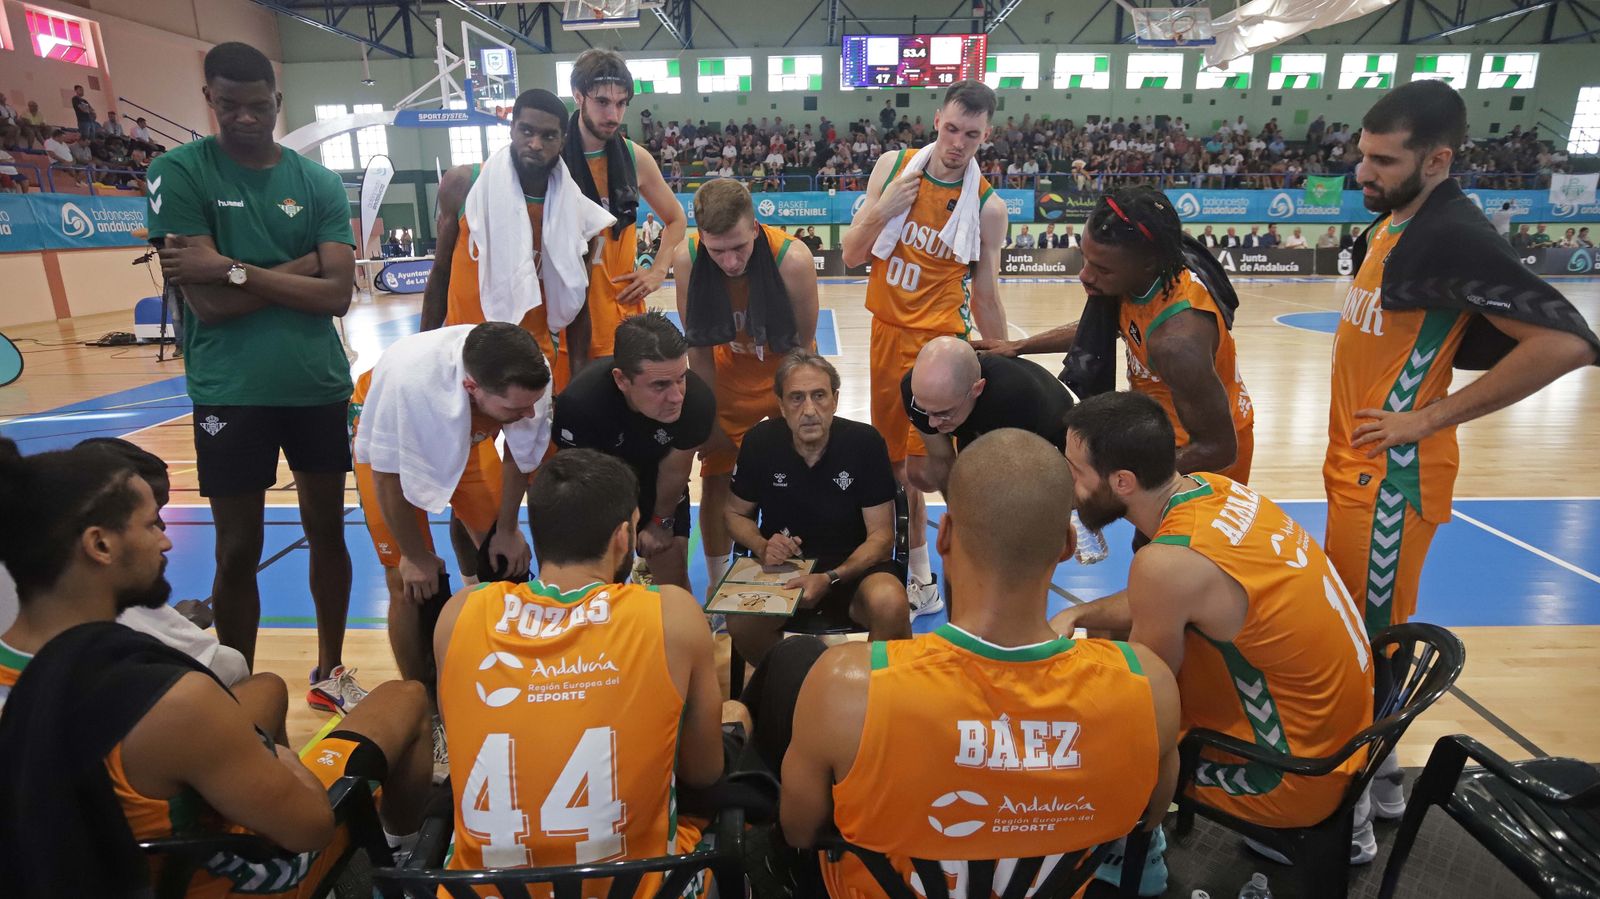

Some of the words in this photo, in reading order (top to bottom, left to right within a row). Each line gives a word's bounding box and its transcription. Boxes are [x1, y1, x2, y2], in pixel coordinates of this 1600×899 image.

[876, 74, 890, 84] 17
[938, 73, 953, 83] 18
[217, 199, 244, 208] hummel
[778, 200, 808, 208] BASKET
[91, 208, 144, 221] baloncesto
[778, 207, 827, 217] SOSTENIBLE
[1006, 254, 1033, 263] Junta
[1240, 254, 1267, 263] Junta
[1006, 263, 1019, 272] de
[1019, 262, 1066, 272] Andalucía
[1240, 263, 1251, 272] de
[1252, 262, 1299, 272] Andalucía
[886, 256, 921, 292] 00
[531, 652, 620, 679] Andalucía
[528, 683, 560, 694] Región
[563, 680, 602, 691] Europea
[605, 677, 620, 686] del
[527, 691, 586, 703] DEPORTE
[954, 712, 1081, 771] BÁEZ
[461, 726, 627, 868] 44
[998, 795, 1096, 814] Andalucía
[994, 817, 1029, 826] Región
[1032, 816, 1075, 825] Europea
[992, 824, 1055, 833] DEPORTE
